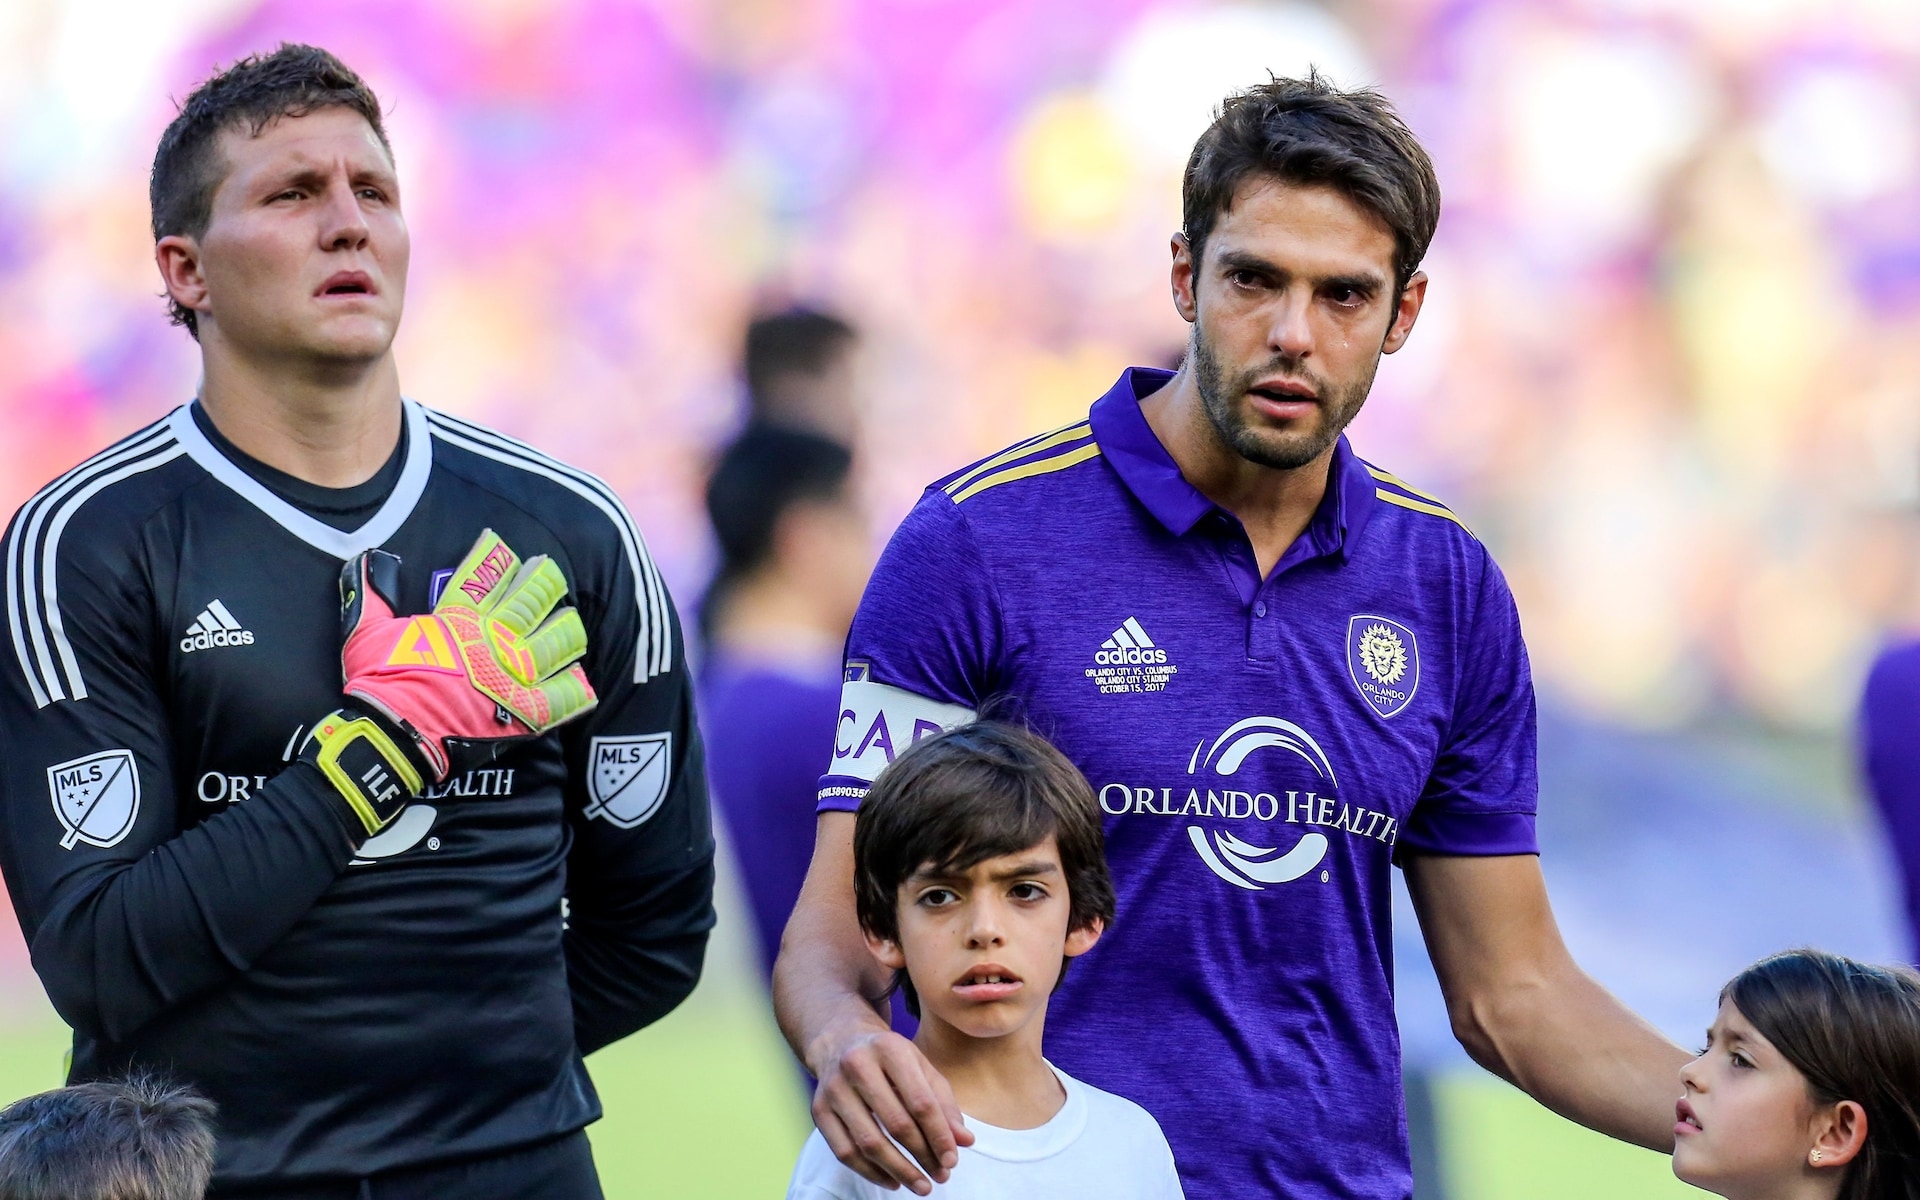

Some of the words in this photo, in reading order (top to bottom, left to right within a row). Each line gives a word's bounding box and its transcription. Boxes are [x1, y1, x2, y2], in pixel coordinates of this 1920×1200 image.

[180, 628, 255, 653] adidas
[1094, 646, 1167, 665] adidas
[1085, 668, 1115, 677] ORLANDO
[1117, 667, 1131, 676] CITY
[1133, 666, 1144, 676] VS.
[1145, 665, 1178, 675] COLUMBUS
[1095, 676, 1125, 686] ORLANDO
[1126, 675, 1141, 685] CITY
[1142, 674, 1170, 684] STADIUM
[1100, 685, 1130, 694] OCTOBER
[1131, 684, 1143, 693] 15,
[1145, 683, 1166, 692] 2017
[1362, 682, 1406, 701] ORLANDO
[1374, 695, 1393, 707] CITY
[601, 747, 640, 764] MLS
[60, 765, 103, 790] MLS
[361, 763, 401, 803] ILF
[1098, 783, 1279, 821] ORLANDO
[1285, 791, 1398, 846] HEALTH
